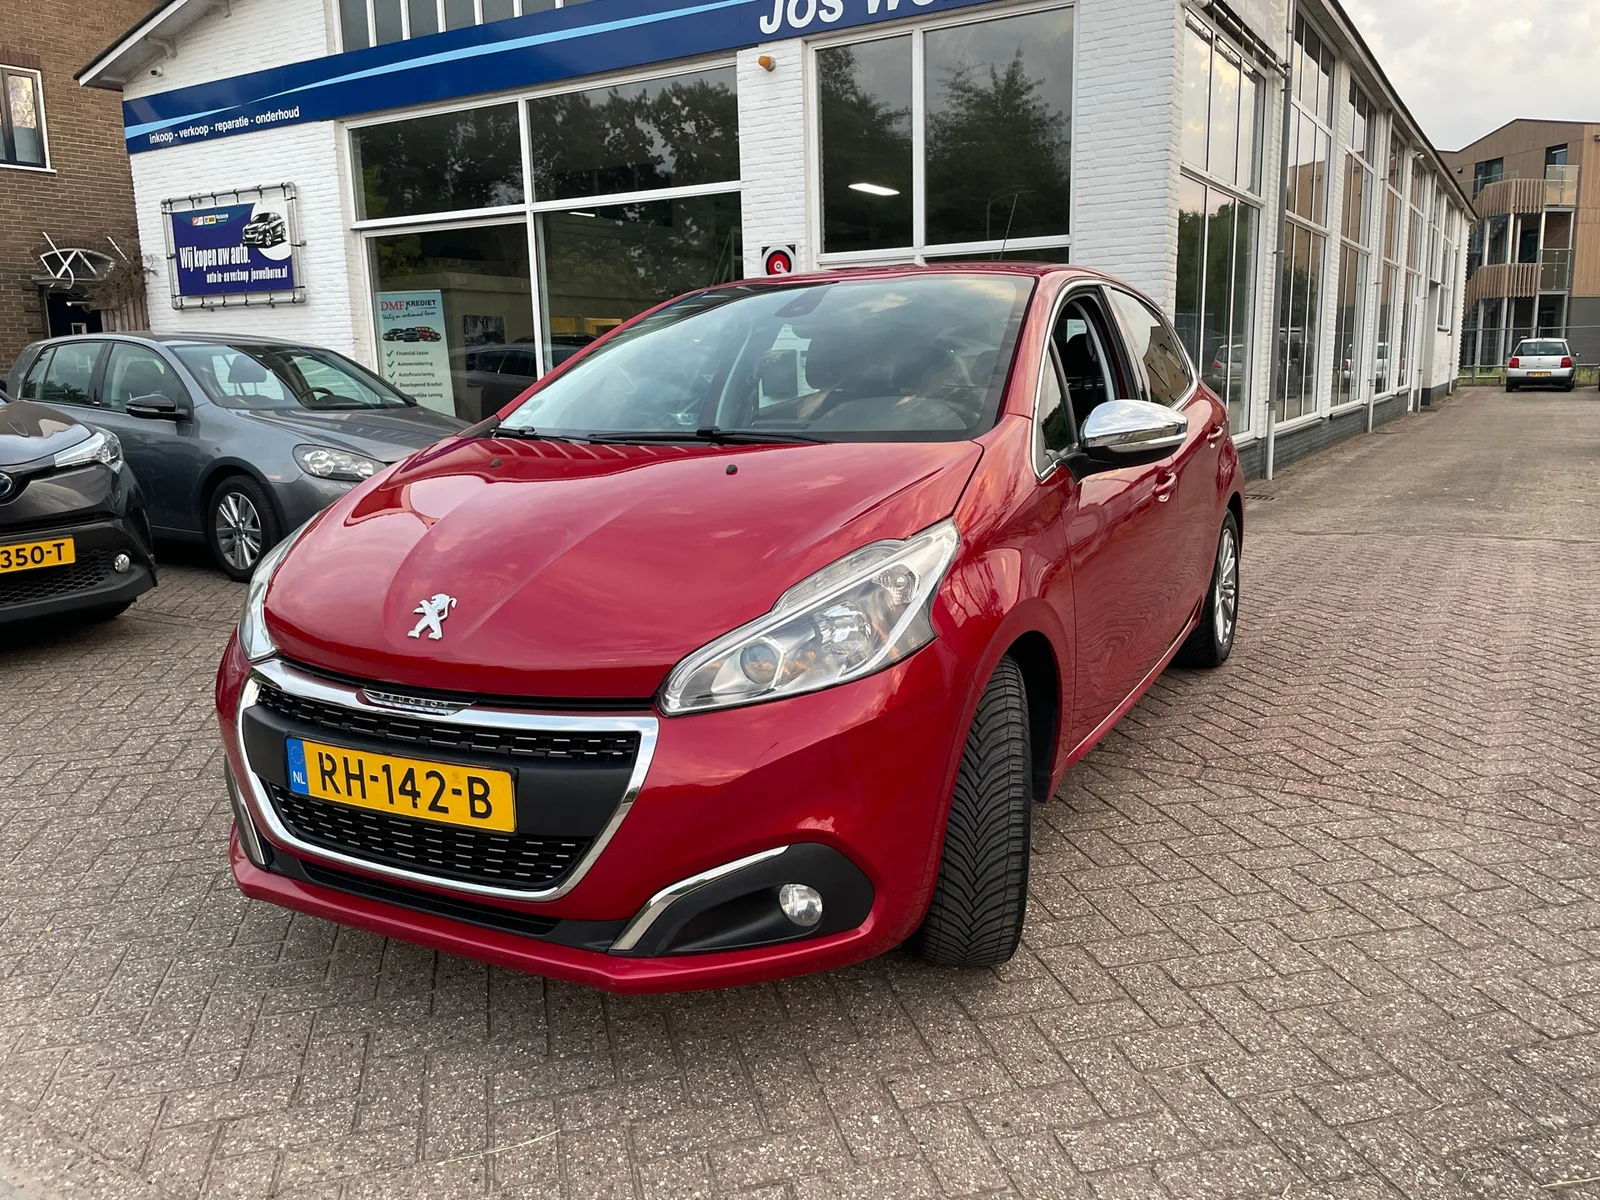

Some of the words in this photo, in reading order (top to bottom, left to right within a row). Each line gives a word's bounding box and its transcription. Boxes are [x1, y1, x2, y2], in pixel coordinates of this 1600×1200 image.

[149, 133, 174, 144] inkoop
[179, 124, 208, 138] verkoop
[214, 116, 249, 133] reparatie
[256, 106, 300, 124] onderhoud
[180, 246, 194, 272] Wij
[194, 246, 216, 271] kopen
[218, 248, 230, 266] uw
[230, 243, 250, 264] auto.
[230, 269, 248, 283] verkoop
[380, 301, 404, 311] DMF
[406, 300, 436, 308] KREDIET
[0, 542, 65, 569] 350-T
[292, 771, 306, 785] NL
[317, 752, 493, 820] RH-142-B
